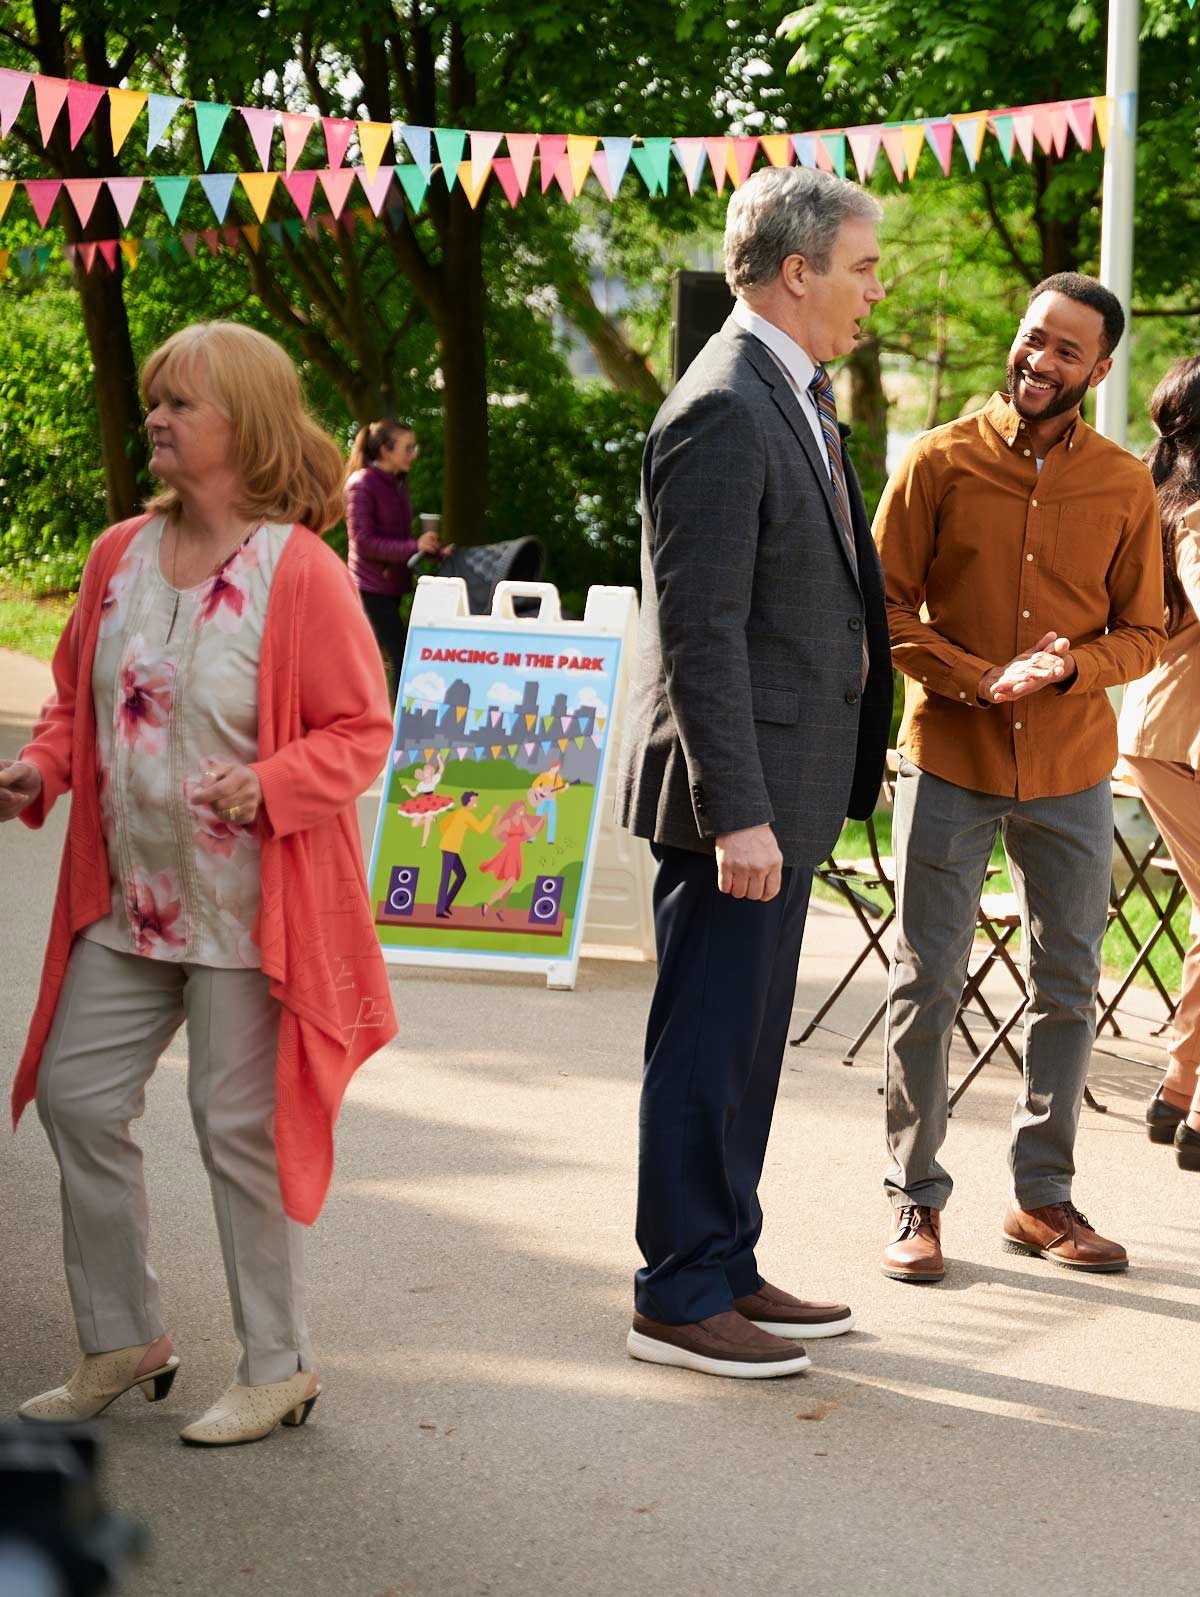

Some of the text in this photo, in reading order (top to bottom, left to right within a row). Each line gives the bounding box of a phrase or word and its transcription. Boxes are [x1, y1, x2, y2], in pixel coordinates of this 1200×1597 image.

[420, 647, 605, 671] DANCING IN THE PARK
